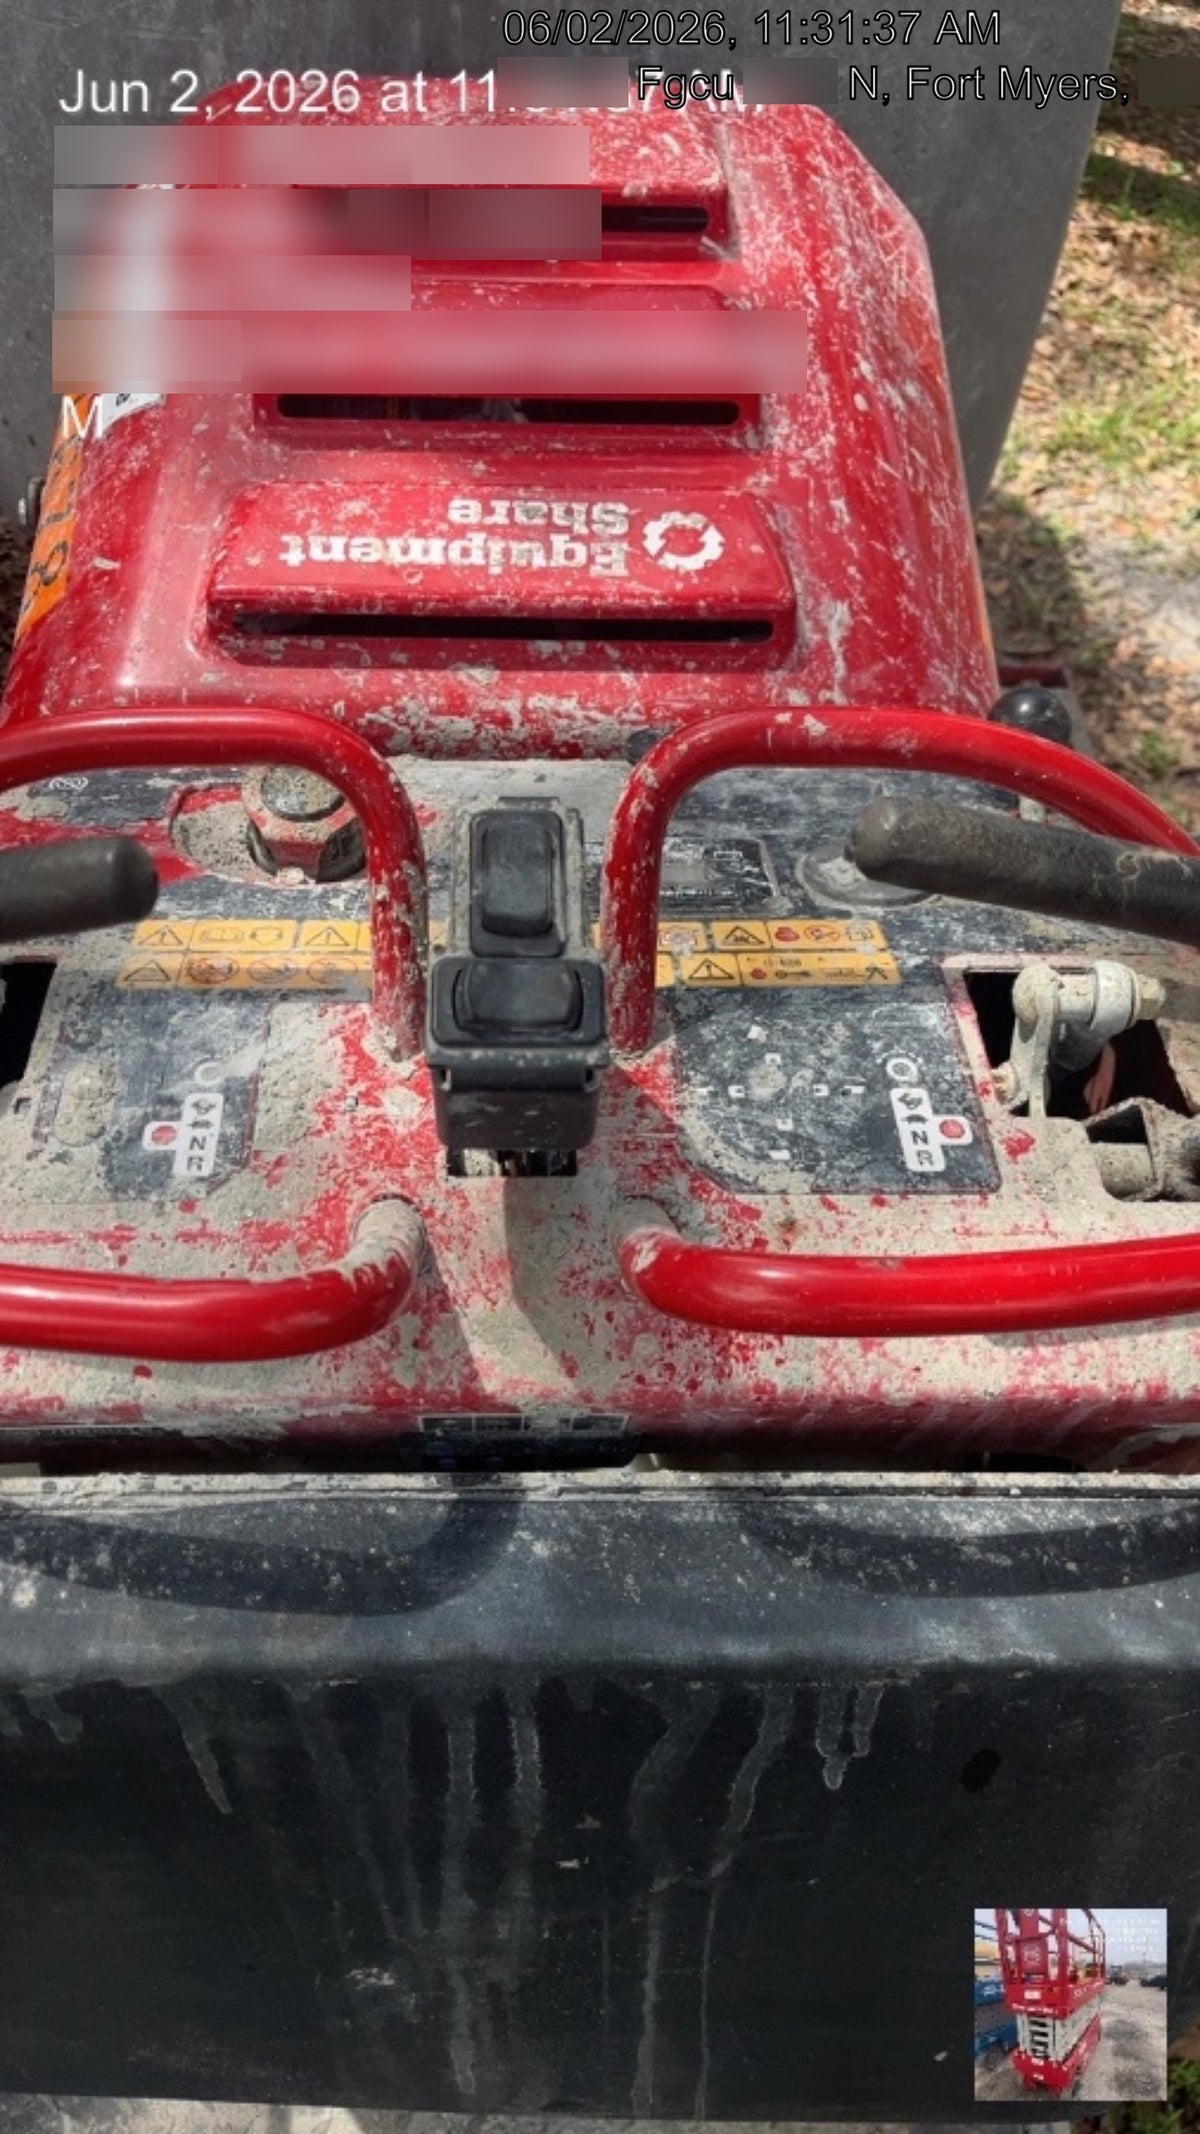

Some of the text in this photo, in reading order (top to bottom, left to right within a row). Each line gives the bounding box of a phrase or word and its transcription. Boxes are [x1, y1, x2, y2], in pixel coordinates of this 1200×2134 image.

[447, 499, 629, 534] Share
[280, 533, 630, 576] Equipment
[189, 1135, 207, 1151] N
[910, 1130, 929, 1146] N
